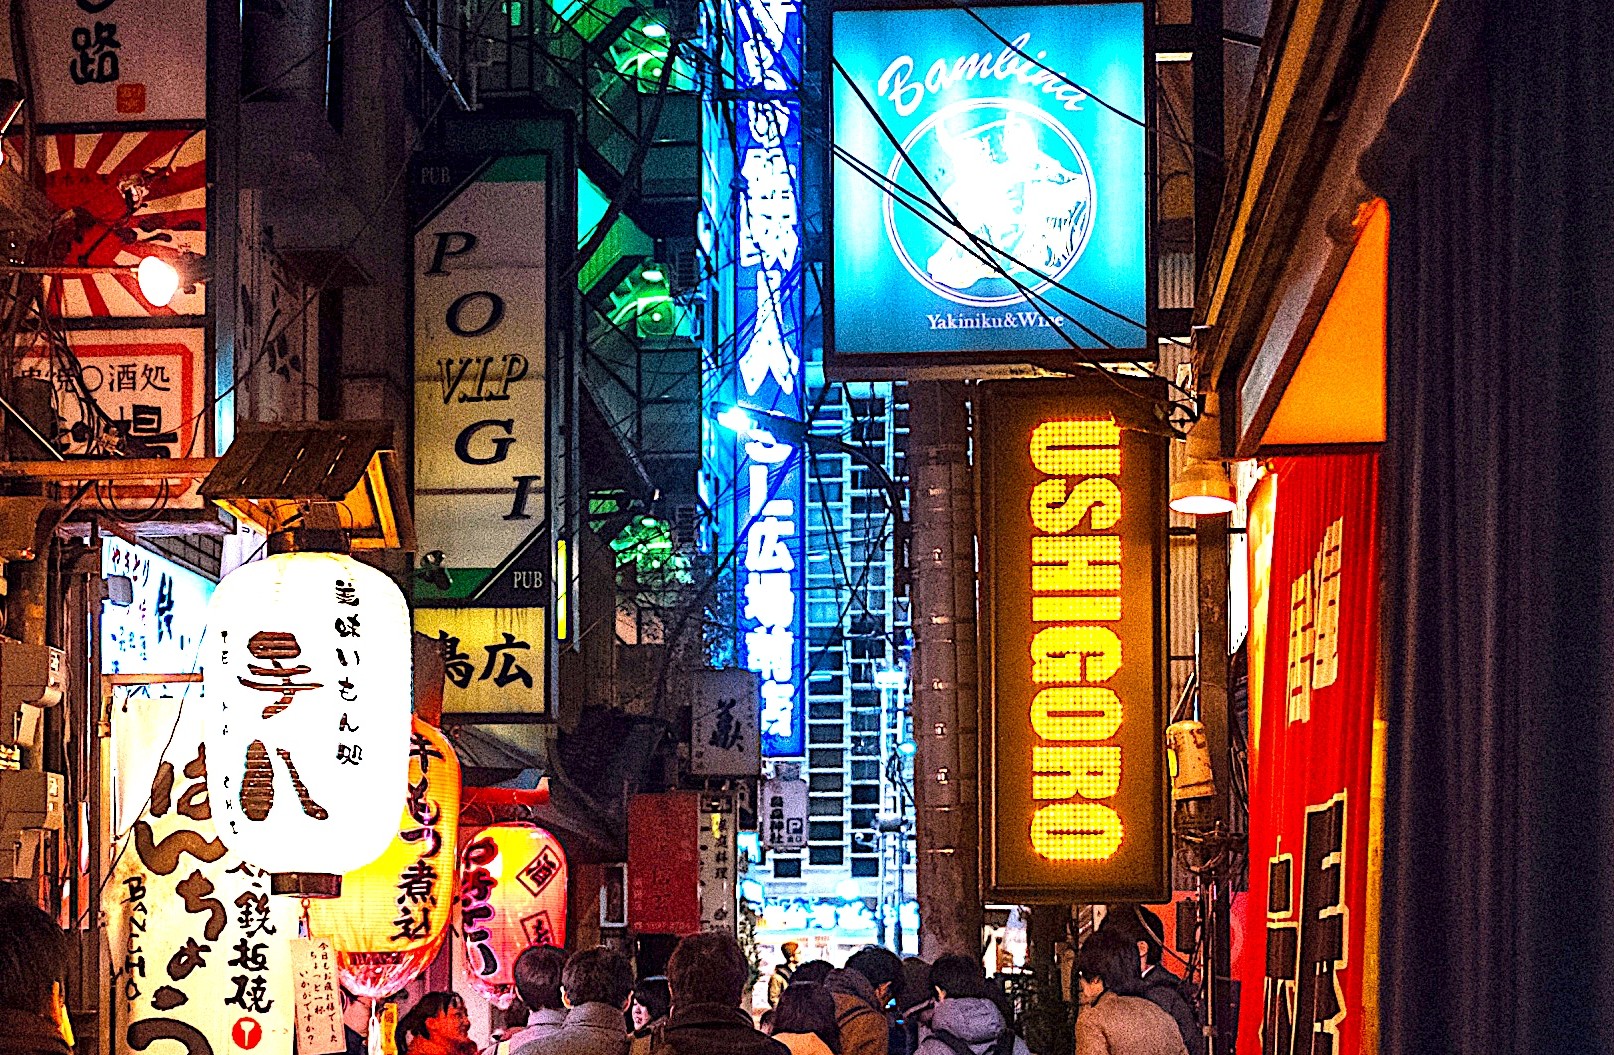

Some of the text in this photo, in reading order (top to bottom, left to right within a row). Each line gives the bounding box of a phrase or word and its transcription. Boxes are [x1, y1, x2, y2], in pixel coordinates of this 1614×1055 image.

[70, 0, 122, 84] 路
[878, 33, 1091, 117] Bambina
[420, 166, 451, 185] PUB
[513, 569, 543, 590] PUB
[1030, 420, 1124, 861] USHIGORO
